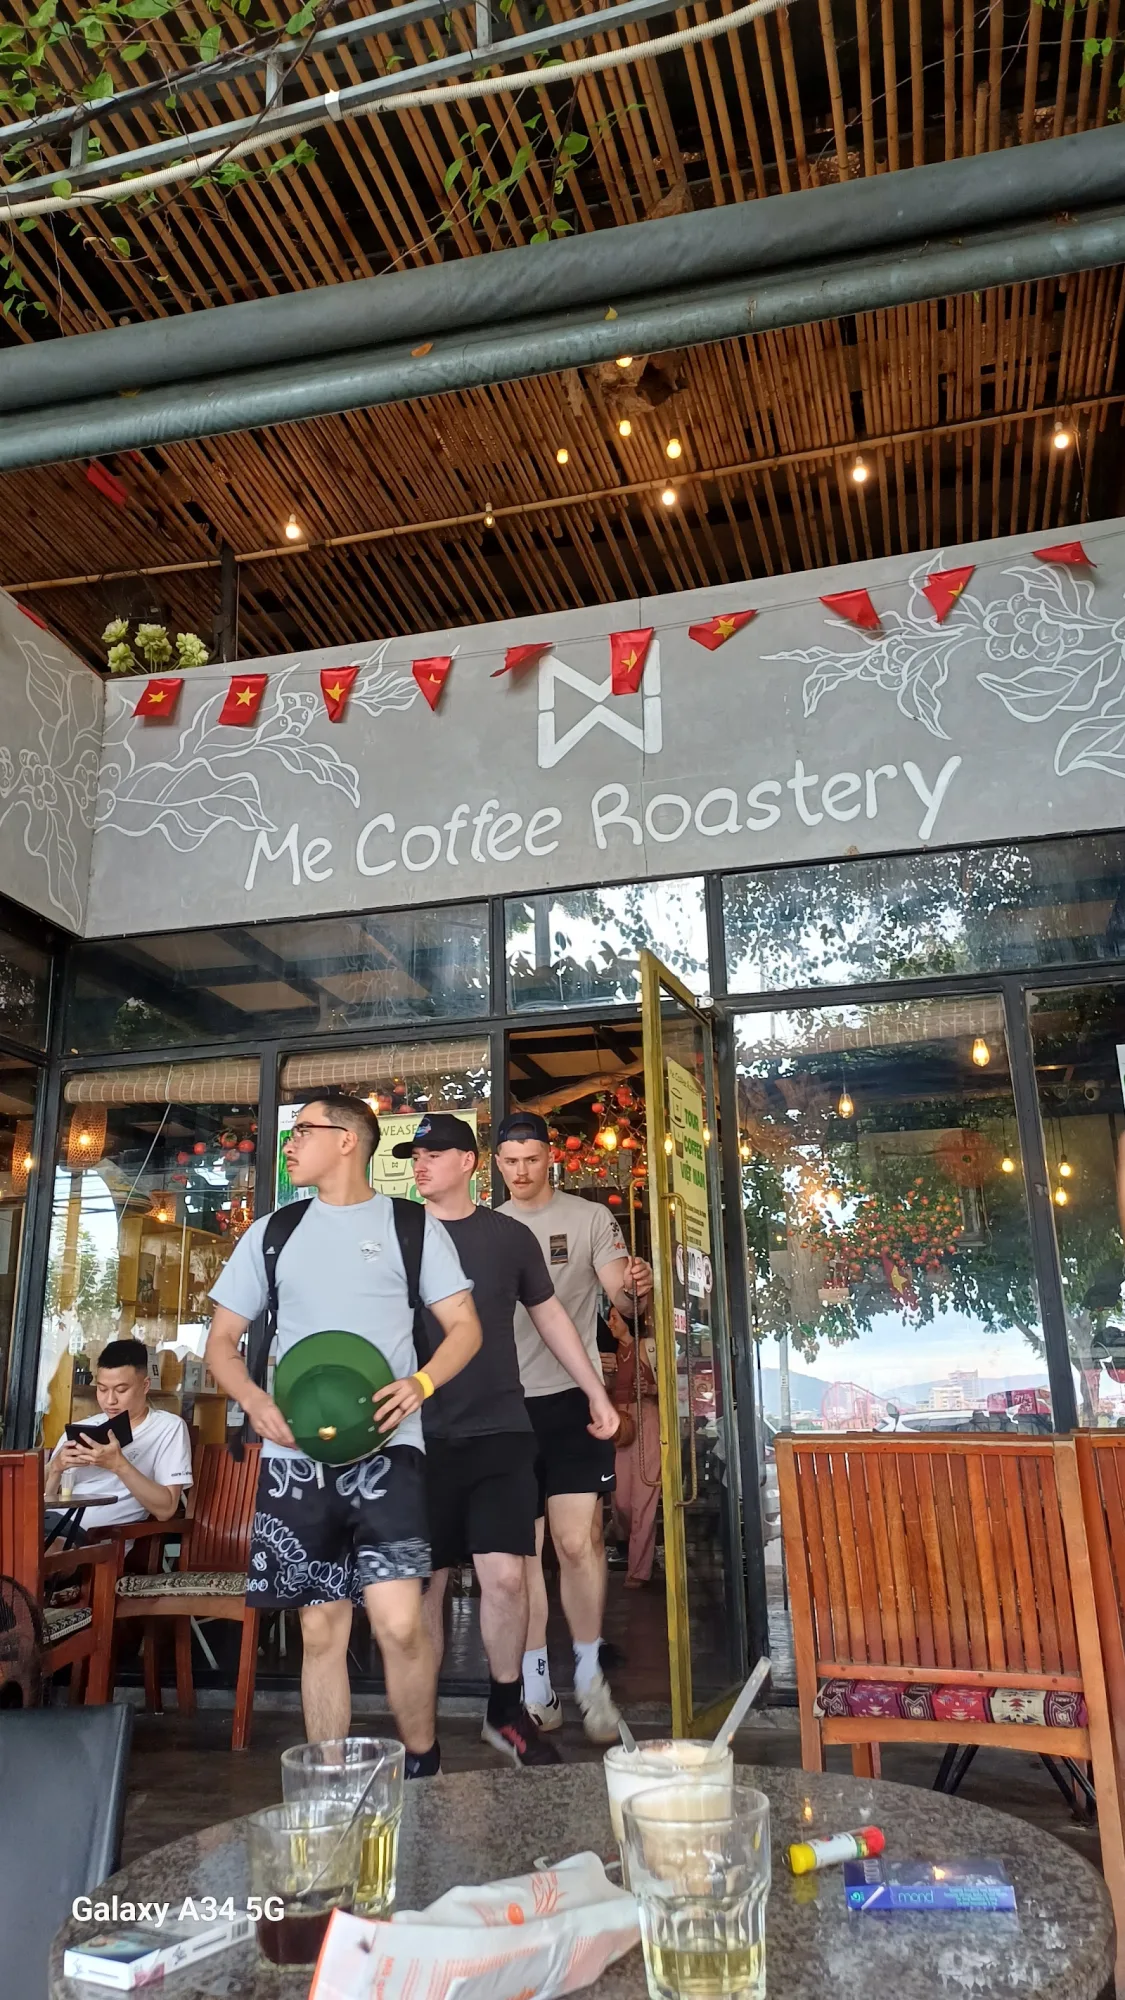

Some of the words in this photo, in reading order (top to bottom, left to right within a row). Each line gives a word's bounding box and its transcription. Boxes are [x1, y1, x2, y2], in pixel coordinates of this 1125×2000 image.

[243, 825, 334, 891] Me
[355, 799, 563, 877] Coffee
[591, 754, 963, 851] Roastery
[379, 1123, 419, 1137] WEASE
[684, 1107, 700, 1132] TOUR
[683, 1135, 704, 1161] COFFEE
[898, 1889, 934, 1903] mond
